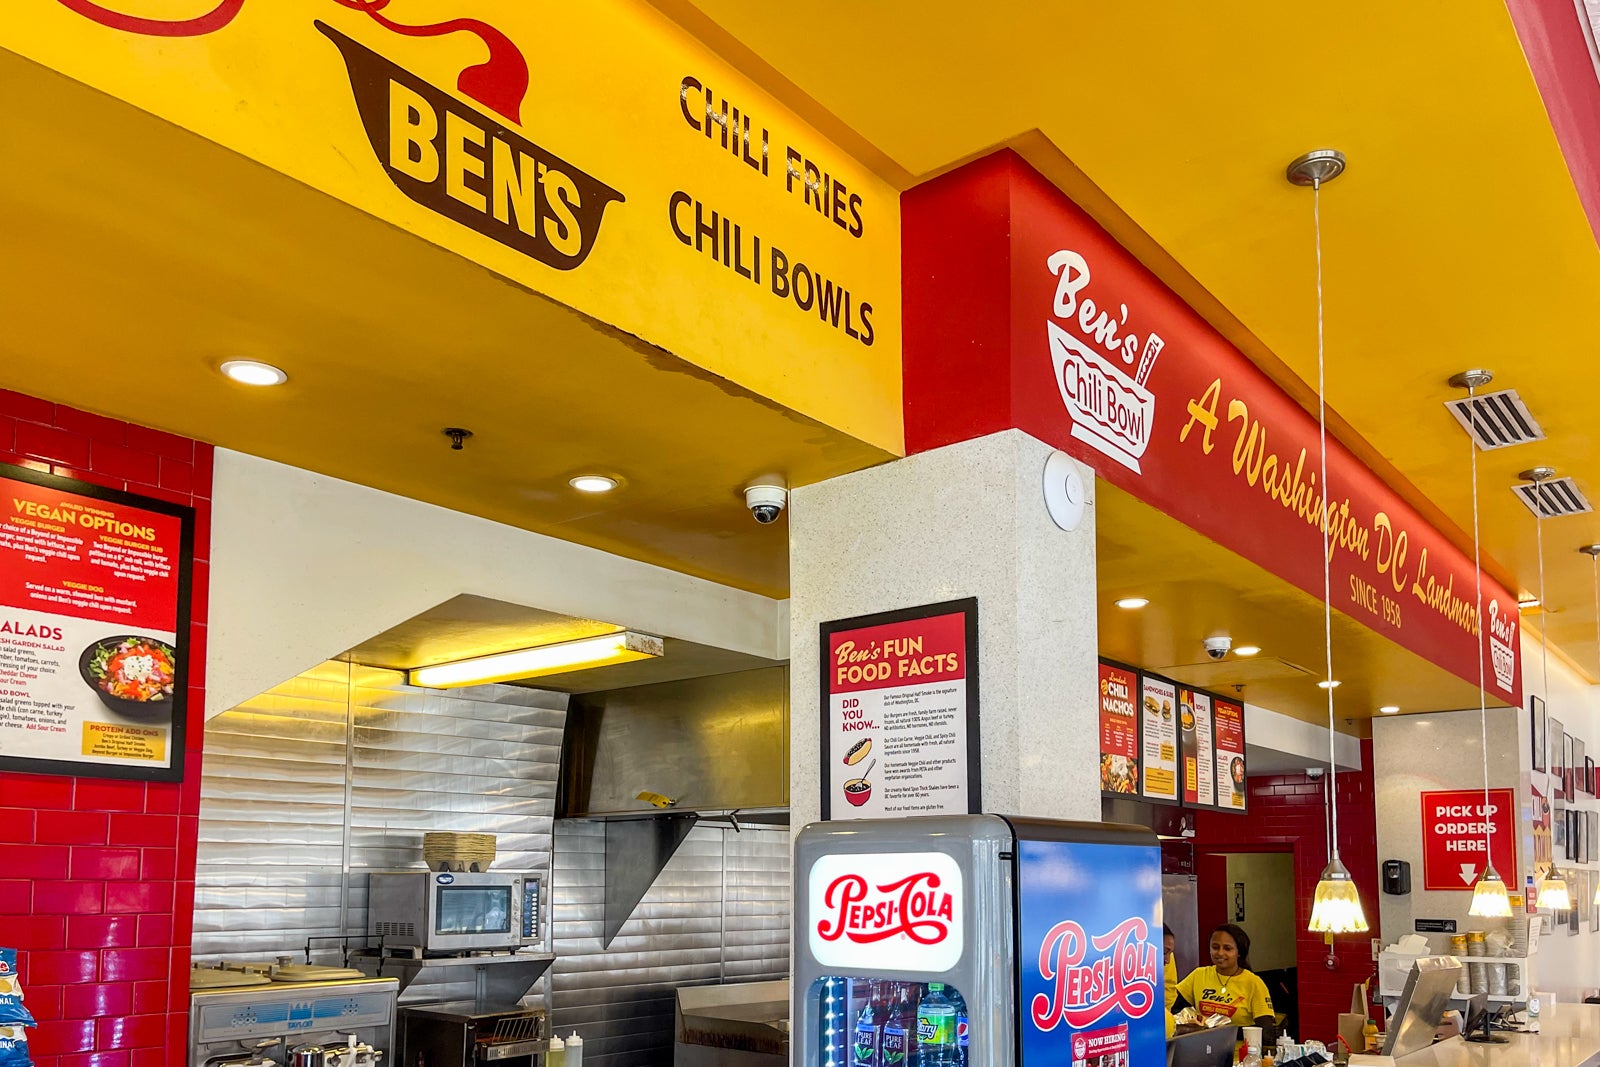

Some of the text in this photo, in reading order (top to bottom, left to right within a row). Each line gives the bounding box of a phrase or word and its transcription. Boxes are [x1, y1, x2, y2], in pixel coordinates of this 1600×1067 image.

[680, 76, 863, 238] CHILI FRIES
[389, 78, 582, 257] BEN'S
[669, 190, 874, 346] CHILI BOWLS
[1047, 250, 1138, 364] Ben's
[1063, 359, 1144, 444] Chili Bowl
[1180, 378, 1221, 455] A
[1228, 399, 1370, 562] Washington
[1374, 512, 1408, 592] DC
[60, 502, 84, 511] AWARD
[10, 516, 65, 533] VEGGIE BURGER
[13, 498, 156, 541] VEGAN OPTIONS
[99, 535, 163, 553] VEGGIE BURGER SUB
[62, 580, 104, 593] VEGGIE DOG
[1350, 574, 1402, 628] SINCE 1958
[1488, 599, 1510, 642] Ben's
[0, 620, 63, 640] ALADS
[12, 640, 41, 648] GARDEN
[835, 636, 923, 666] Ben's FUN
[837, 653, 958, 685] FOOD FACTS
[1108, 682, 1128, 699] CHILI
[842, 698, 859, 709] DID
[1102, 697, 1134, 717] NACHOS
[12, 715, 37, 723] tomatoes,
[47, 710, 63, 718] turkey
[842, 709, 863, 720] YOU
[90, 724, 124, 733] PROTEIN
[842, 720, 880, 732] KNOW...
[1436, 805, 1498, 817] PICK UP
[1434, 822, 1496, 834] ORDERS
[1446, 840, 1486, 851] HERE
[1202, 989, 1232, 1003] Ben's
[288, 1021, 312, 1029] TAYLOR
[1088, 1033, 1125, 1047] NOW HIRING
